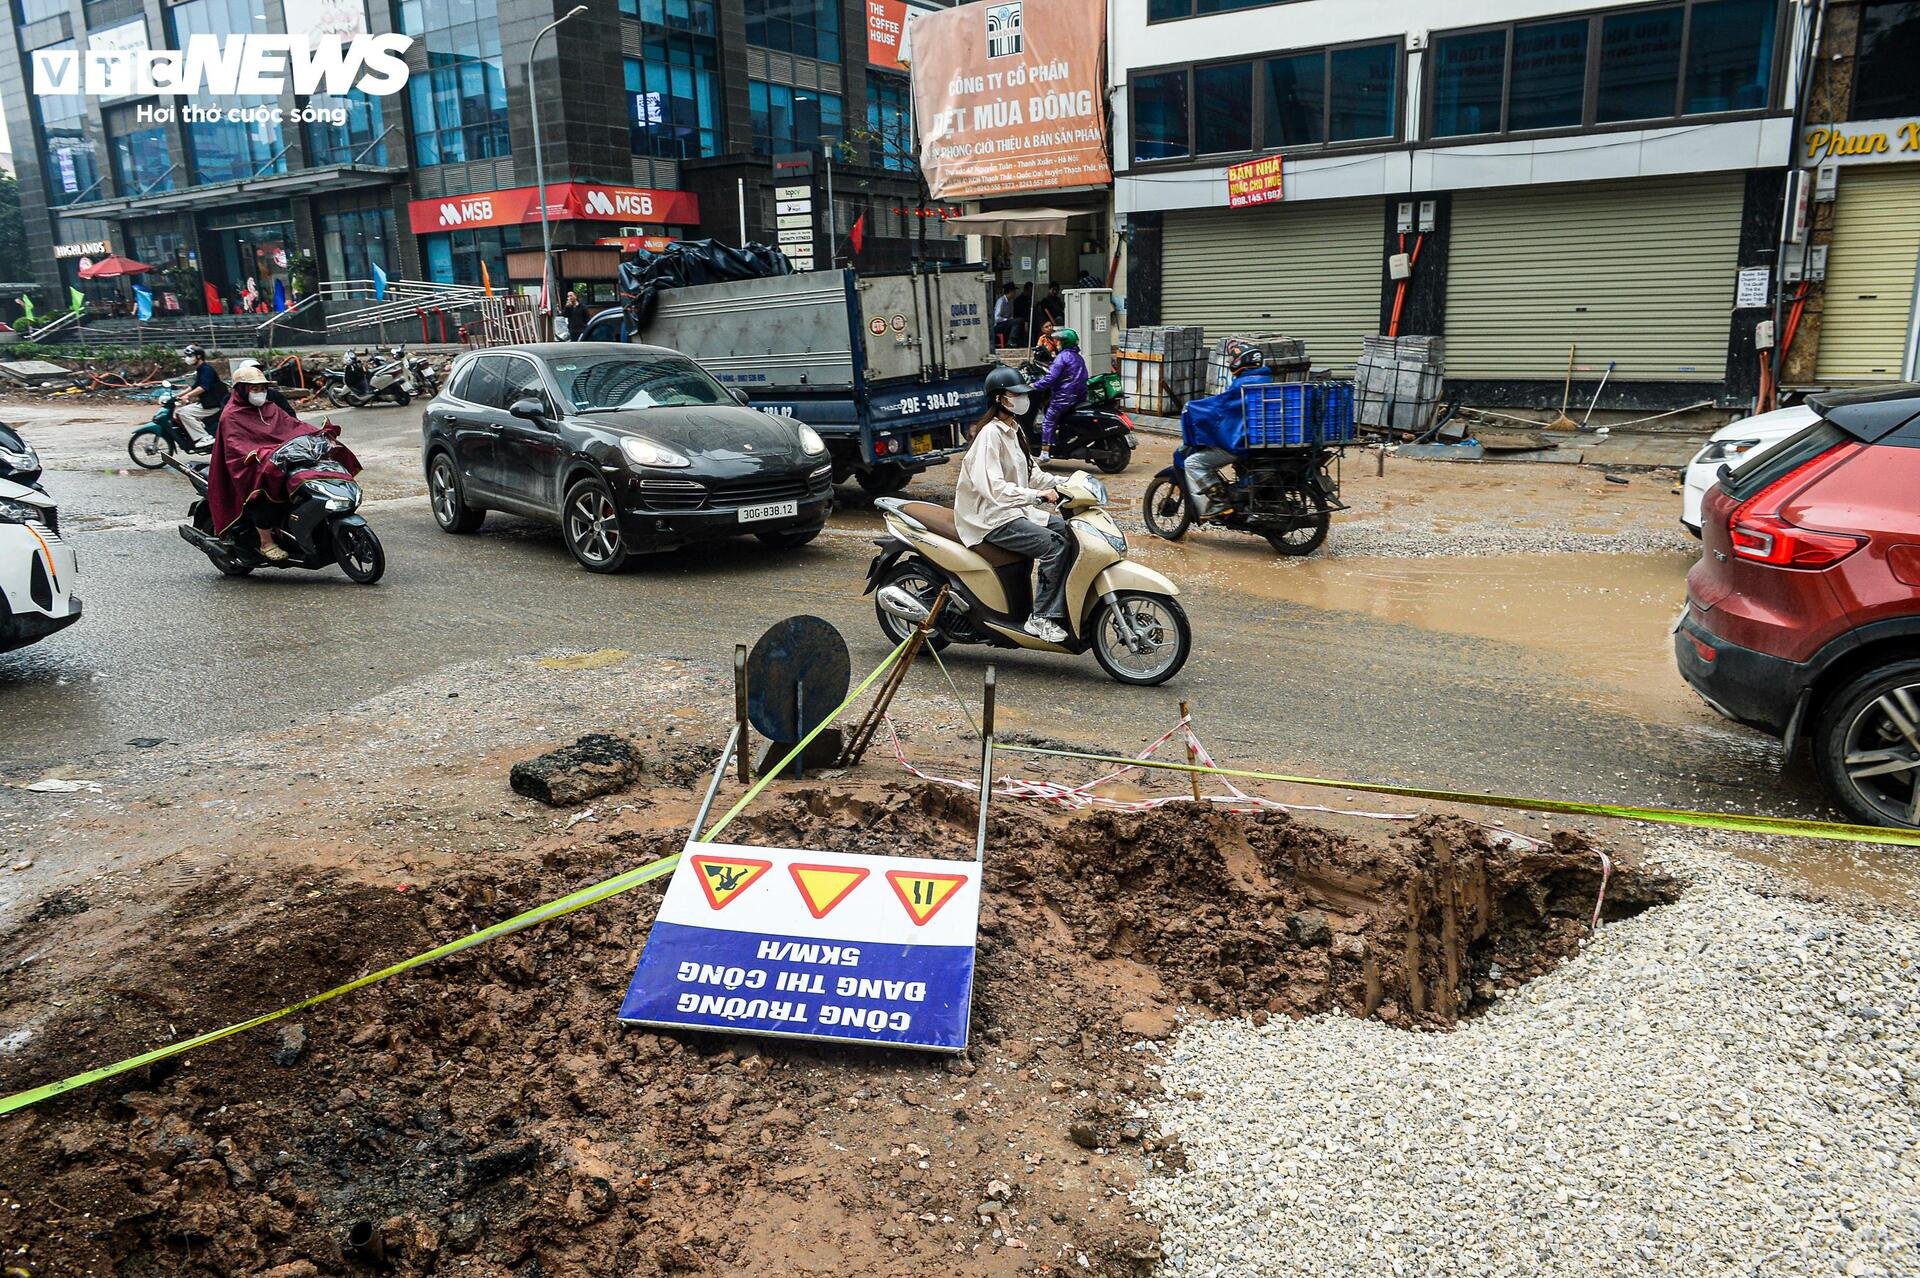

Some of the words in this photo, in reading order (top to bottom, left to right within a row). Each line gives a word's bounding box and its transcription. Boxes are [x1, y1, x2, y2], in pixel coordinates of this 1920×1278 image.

[869, 2, 884, 16] THE
[869, 16, 900, 34] COFFEE
[869, 29, 896, 47] HOUSE
[948, 74, 984, 97] CÔNG
[987, 72, 1003, 91] TY
[974, 97, 1024, 130] MÙA
[1029, 90, 1092, 122] ĐÔNG
[996, 135, 1022, 154] THIỆU
[1024, 138, 1032, 149] &
[1033, 130, 1053, 147] BÁN
[1805, 127, 1890, 158] Phun
[461, 200, 493, 222] MSB
[615, 195, 653, 216] MSB
[55, 241, 106, 257] HIGHLANDS
[900, 396, 920, 415] 29E
[926, 391, 960, 410] 384.02
[743, 504, 793, 519] 30G-838.12
[756, 940, 862, 967] 5KM/H
[676, 961, 768, 991] CÔNG
[775, 971, 826, 994] THI
[836, 976, 927, 1002] ĐANG
[676, 993, 808, 1022] TRƯỜNG
[818, 1004, 911, 1033] CÔNG
